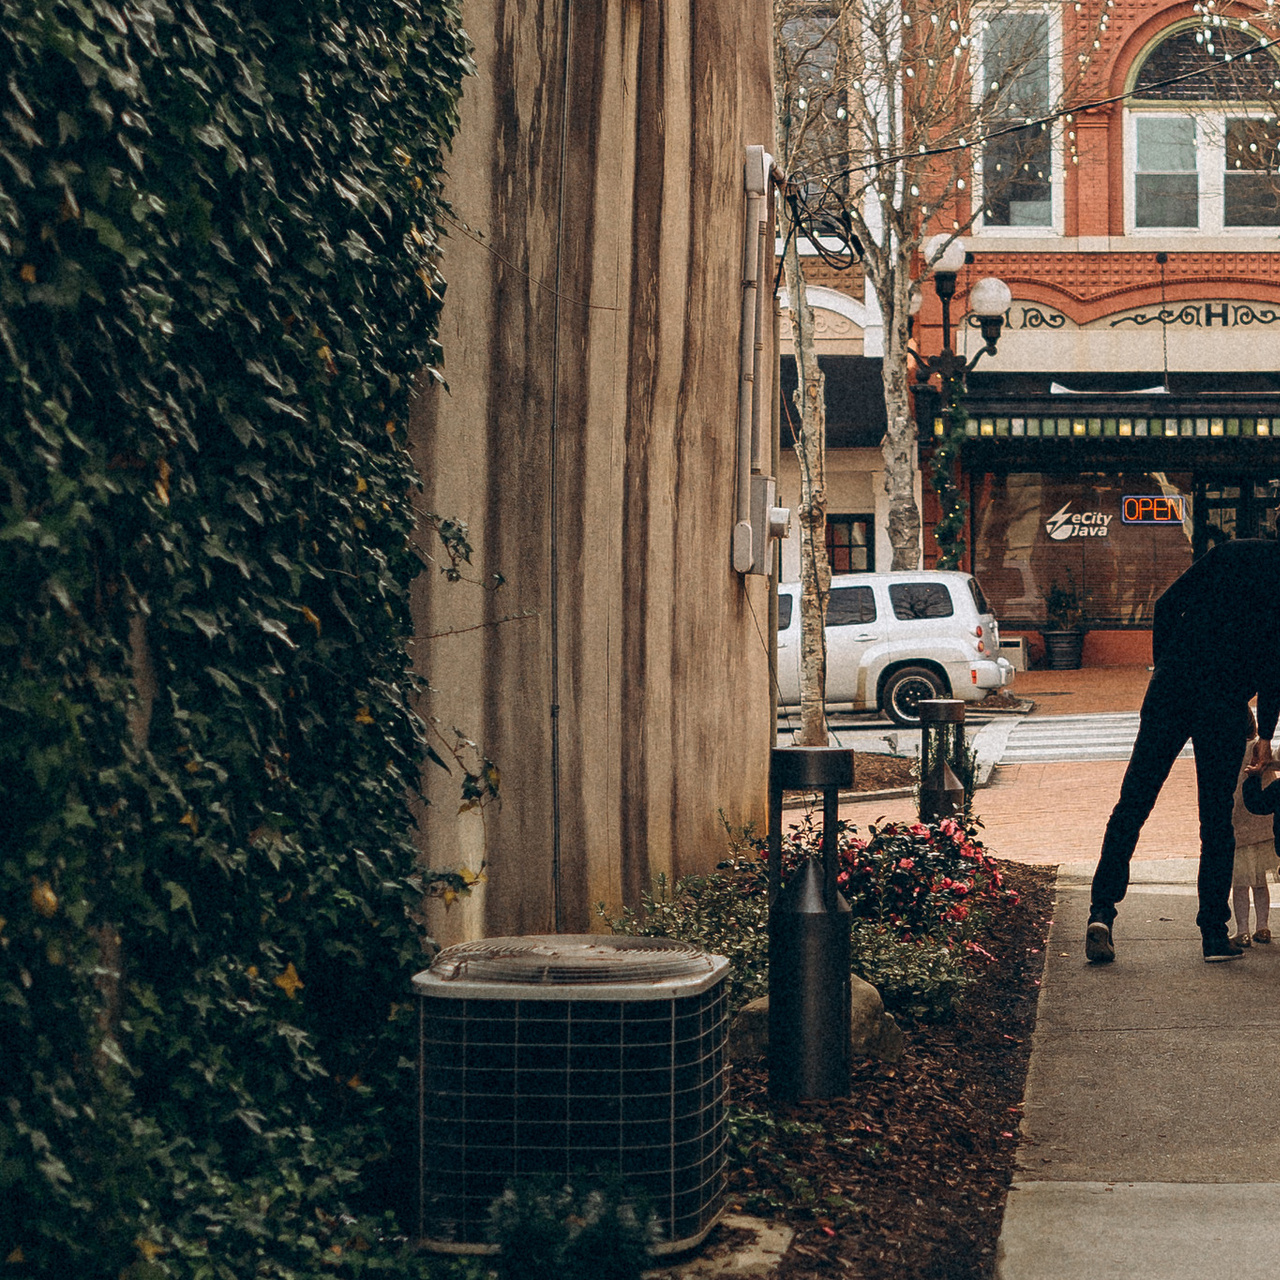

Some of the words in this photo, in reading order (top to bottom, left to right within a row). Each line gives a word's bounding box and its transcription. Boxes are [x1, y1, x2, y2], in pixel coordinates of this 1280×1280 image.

[1205, 303, 1229, 327] H
[1124, 498, 1183, 520] OPEN
[1071, 512, 1113, 526] eCity
[1071, 524, 1108, 537] Java
